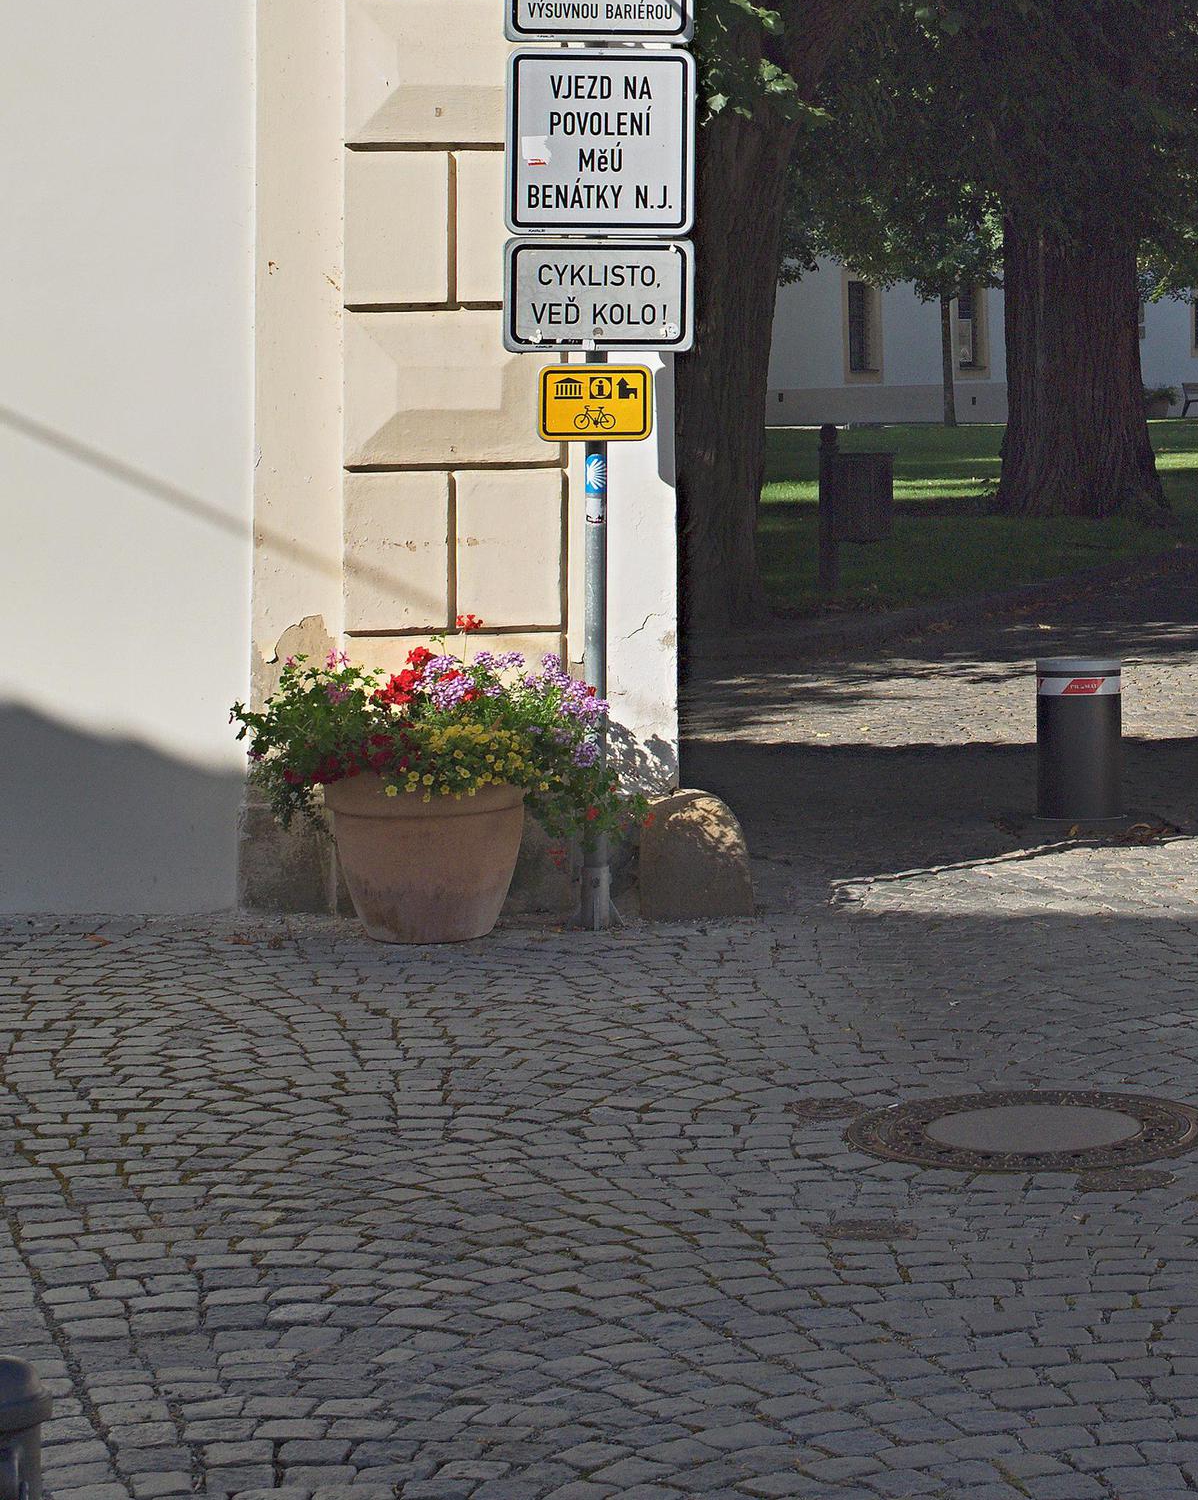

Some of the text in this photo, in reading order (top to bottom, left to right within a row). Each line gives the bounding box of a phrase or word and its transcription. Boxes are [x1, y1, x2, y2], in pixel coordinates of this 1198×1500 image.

[605, 0, 673, 20] BARIÉROU
[550, 74, 653, 100] VJEZD NA
[549, 105, 652, 136] POVOLENÍ
[578, 141, 622, 173] MěÚ
[527, 178, 673, 209] BENÁTKY N.J.
[538, 264, 661, 288] CYKLISTO,
[530, 296, 580, 325] VEĎ
